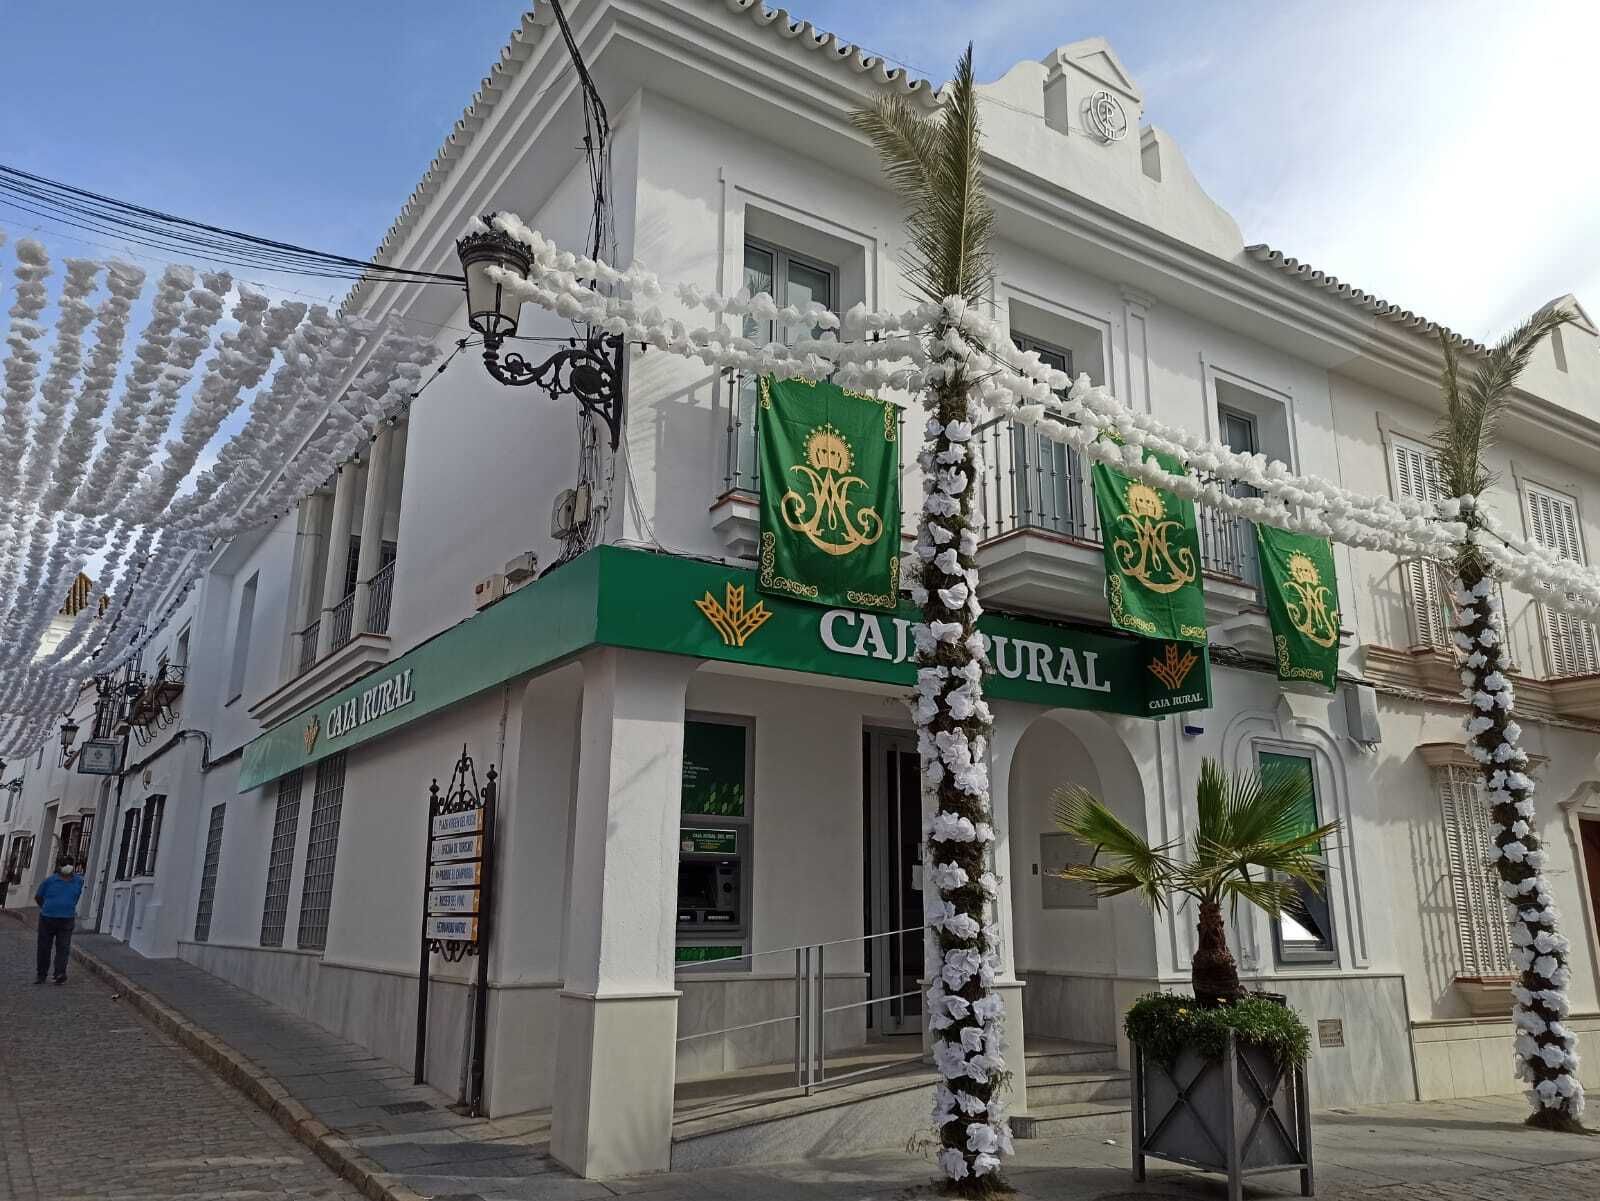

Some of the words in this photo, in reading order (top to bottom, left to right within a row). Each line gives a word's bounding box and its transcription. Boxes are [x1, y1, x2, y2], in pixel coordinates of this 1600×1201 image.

[327, 698, 357, 739] CAJA
[360, 668, 413, 725] RURAL
[1148, 698, 1171, 709] CAJA
[1172, 693, 1204, 706] RURAL
